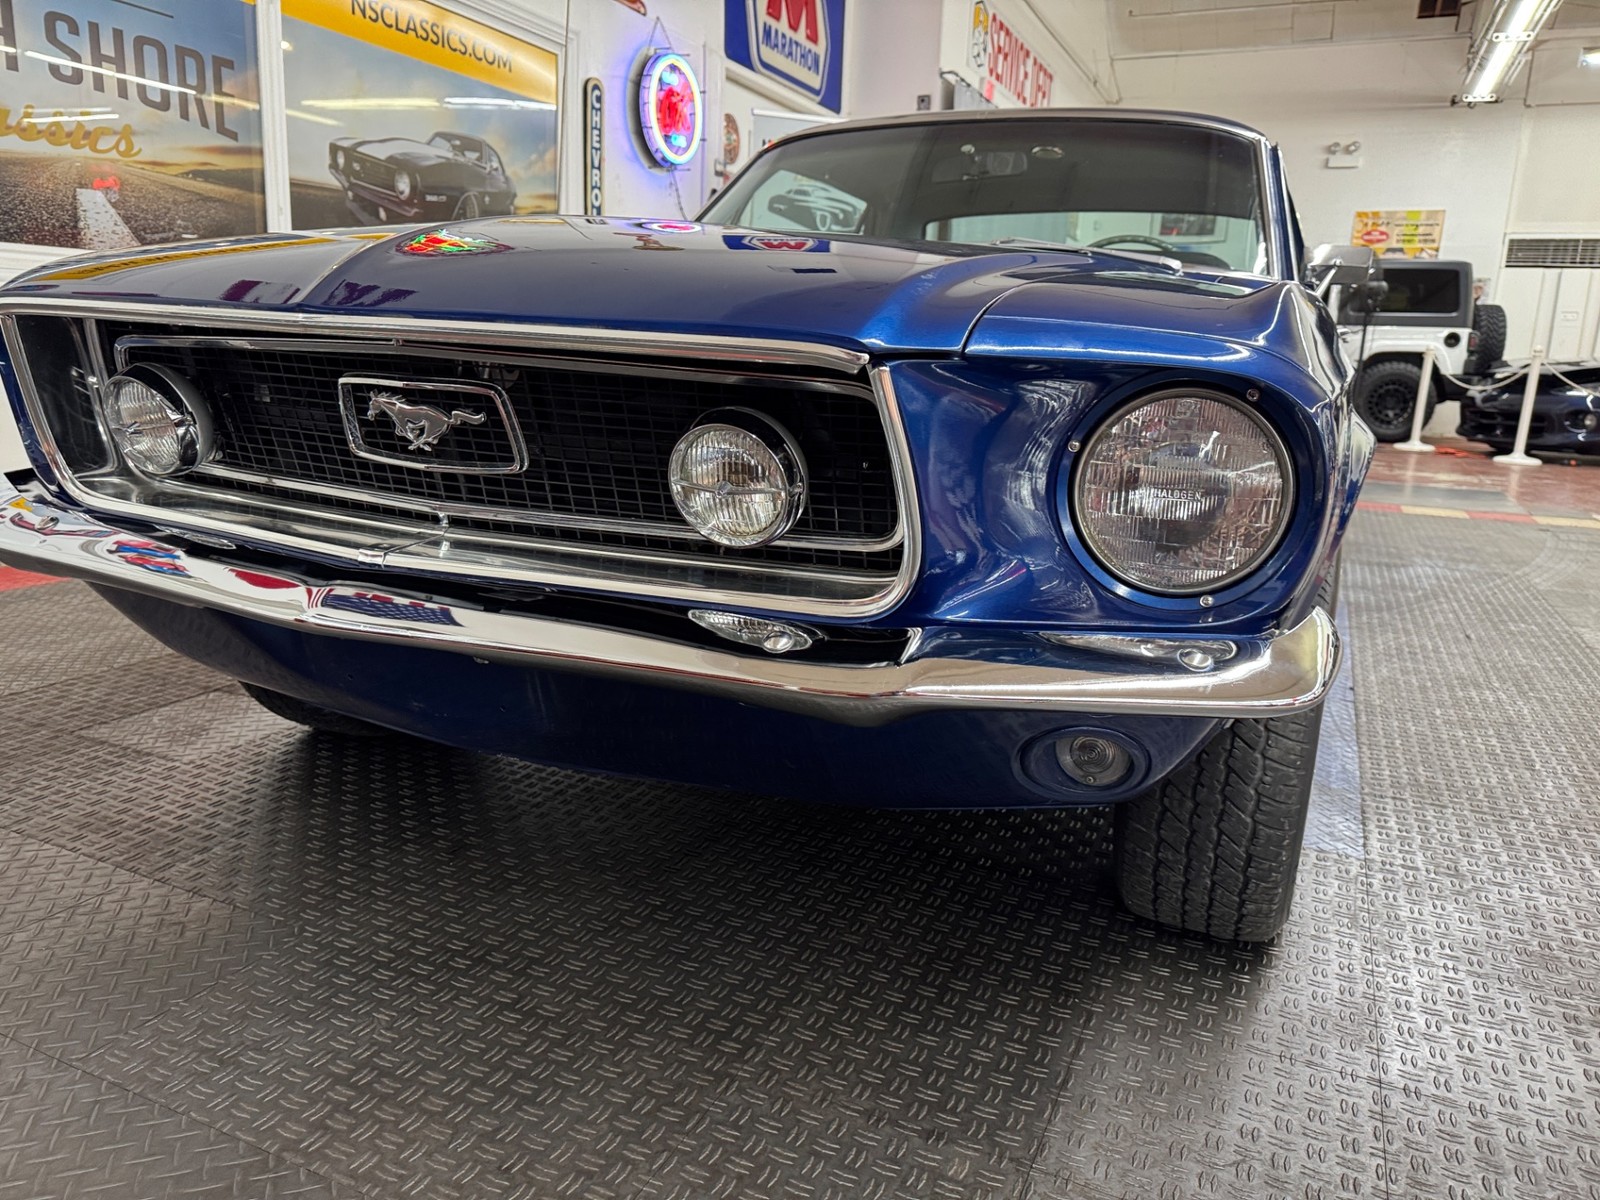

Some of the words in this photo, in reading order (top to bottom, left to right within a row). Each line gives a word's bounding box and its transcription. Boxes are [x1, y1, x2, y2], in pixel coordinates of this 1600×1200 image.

[349, 0, 513, 73] NSCLASSICS.COM
[761, 21, 820, 76] MARATHON
[44, 10, 239, 142] SHORE
[1153, 487, 1202, 500] HALOGEN
